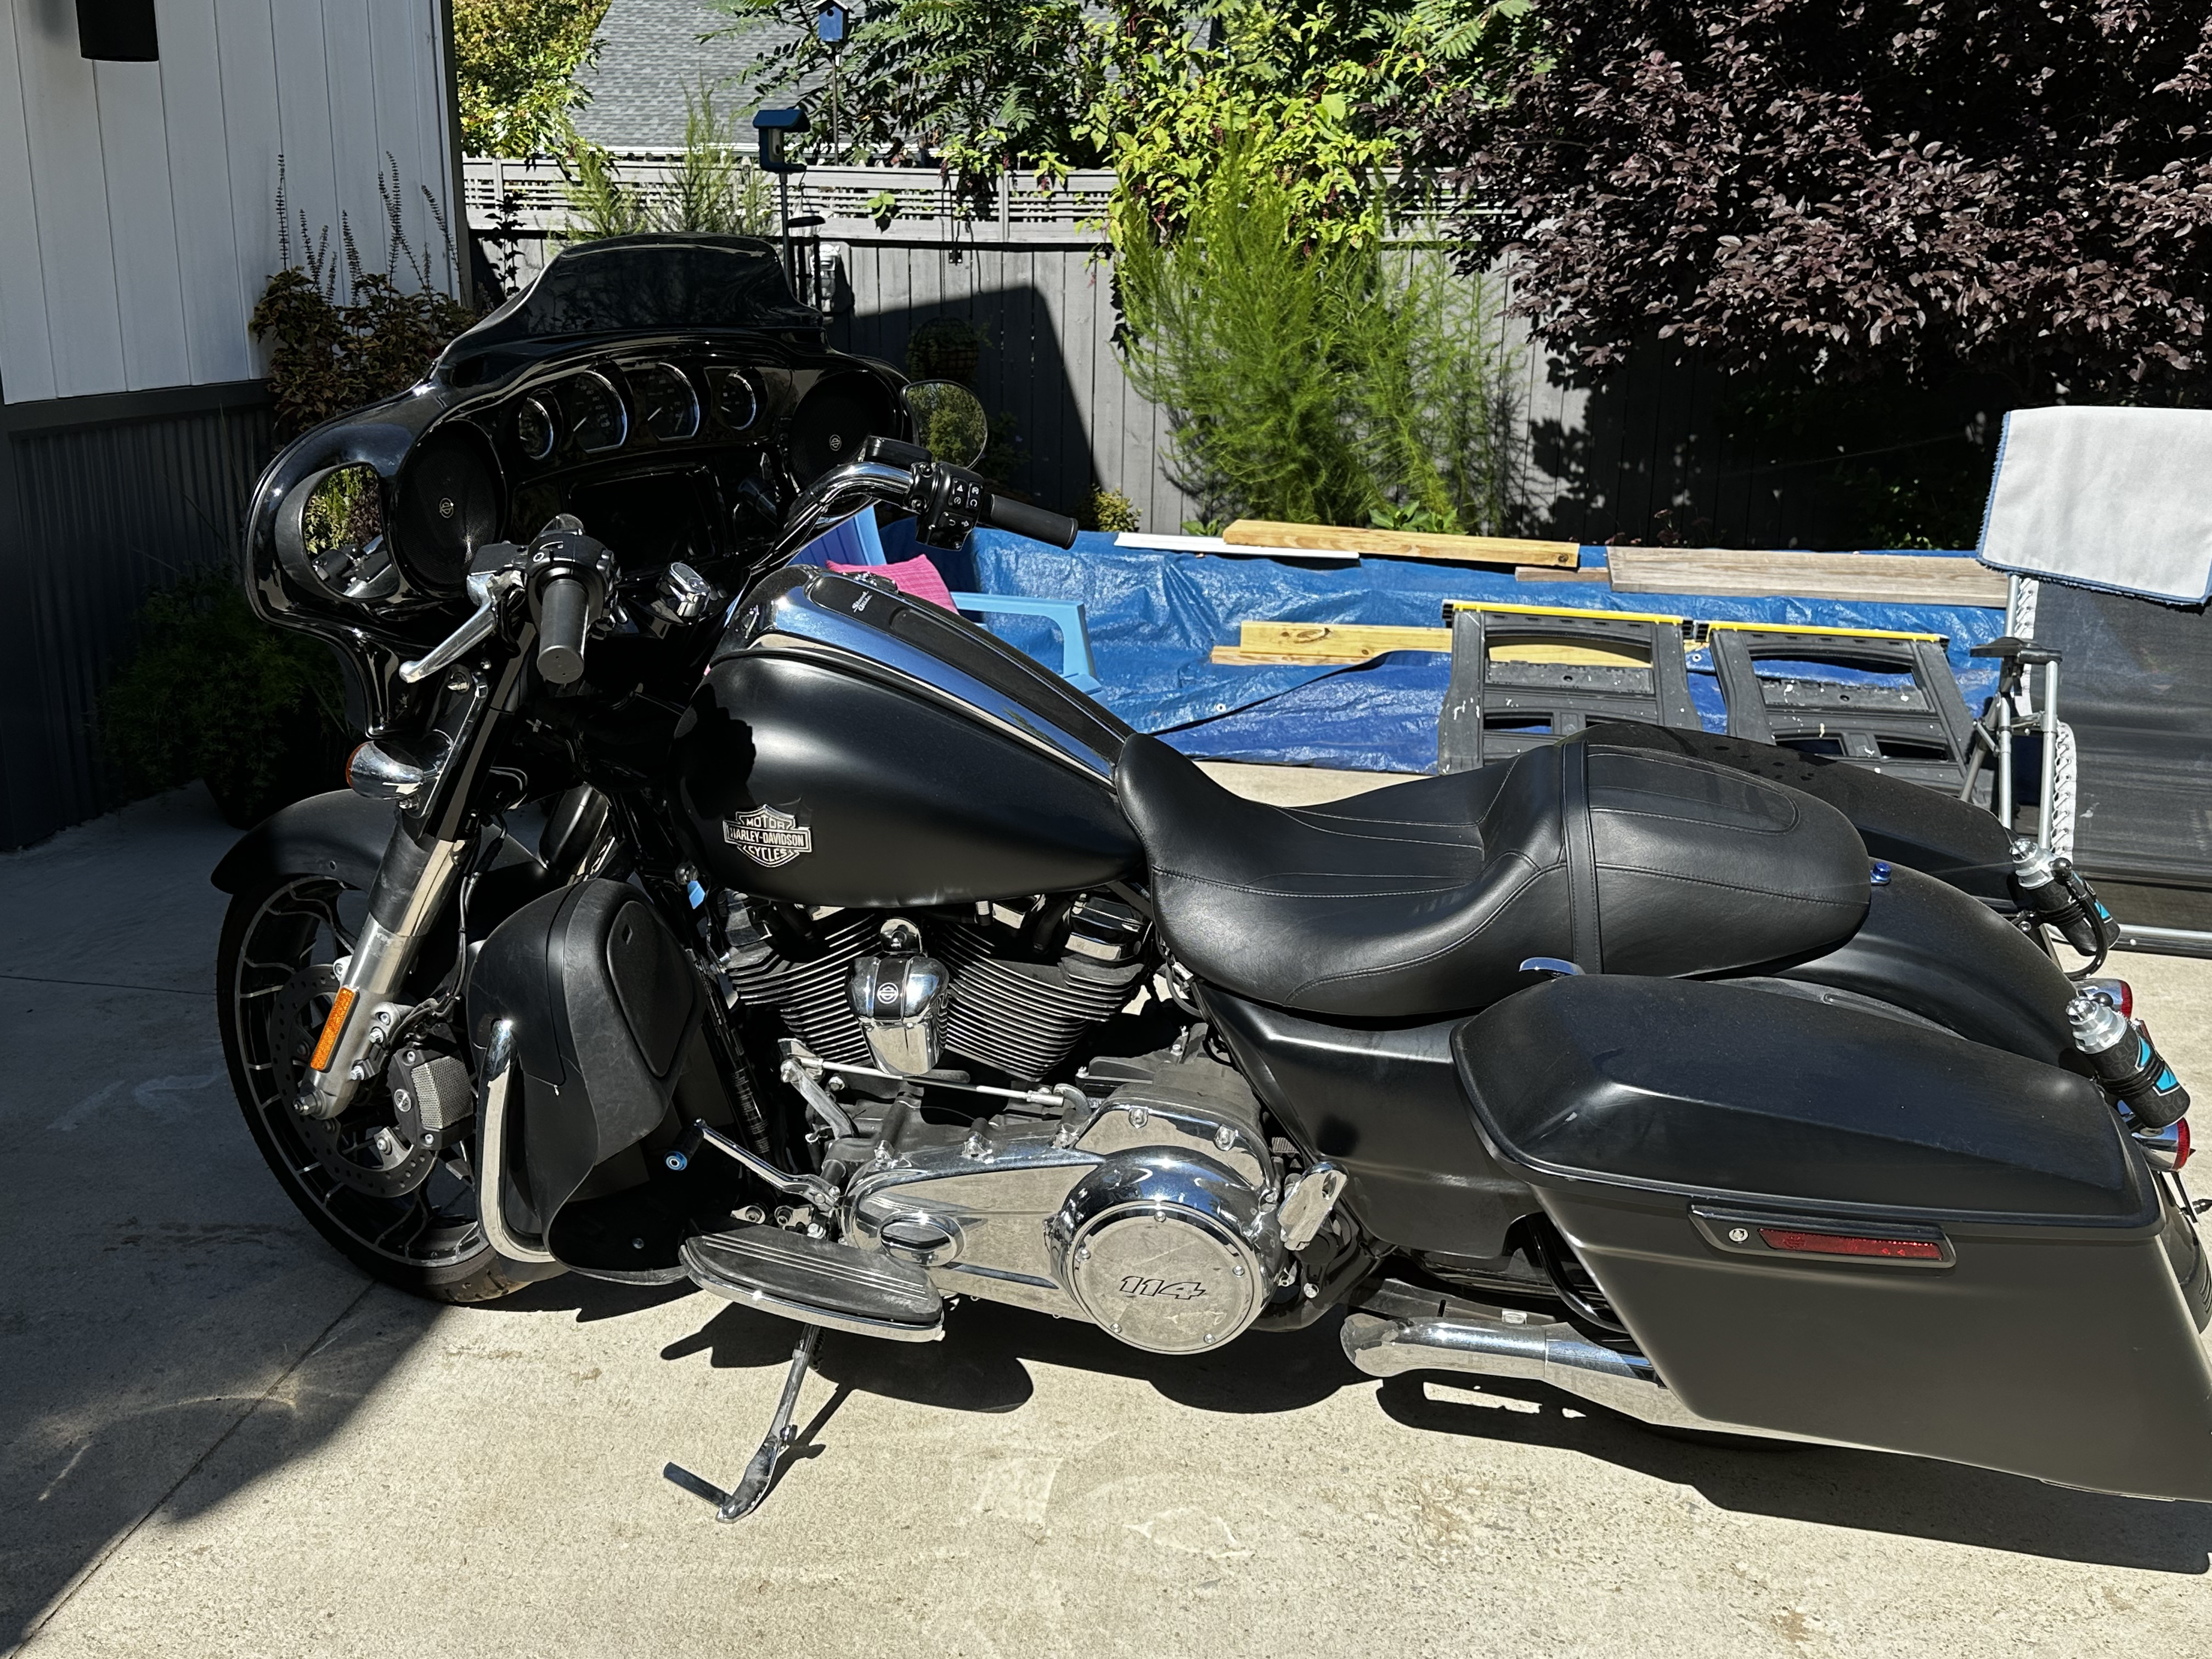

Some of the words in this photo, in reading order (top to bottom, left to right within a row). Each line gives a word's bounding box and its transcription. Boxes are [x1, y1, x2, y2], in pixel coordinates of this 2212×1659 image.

[746, 815, 787, 830] MOTOR
[729, 827, 804, 847] HARLEY-DAVIDSON
[747, 845, 788, 862] CYCLES
[1119, 1276, 1206, 1300] 114
